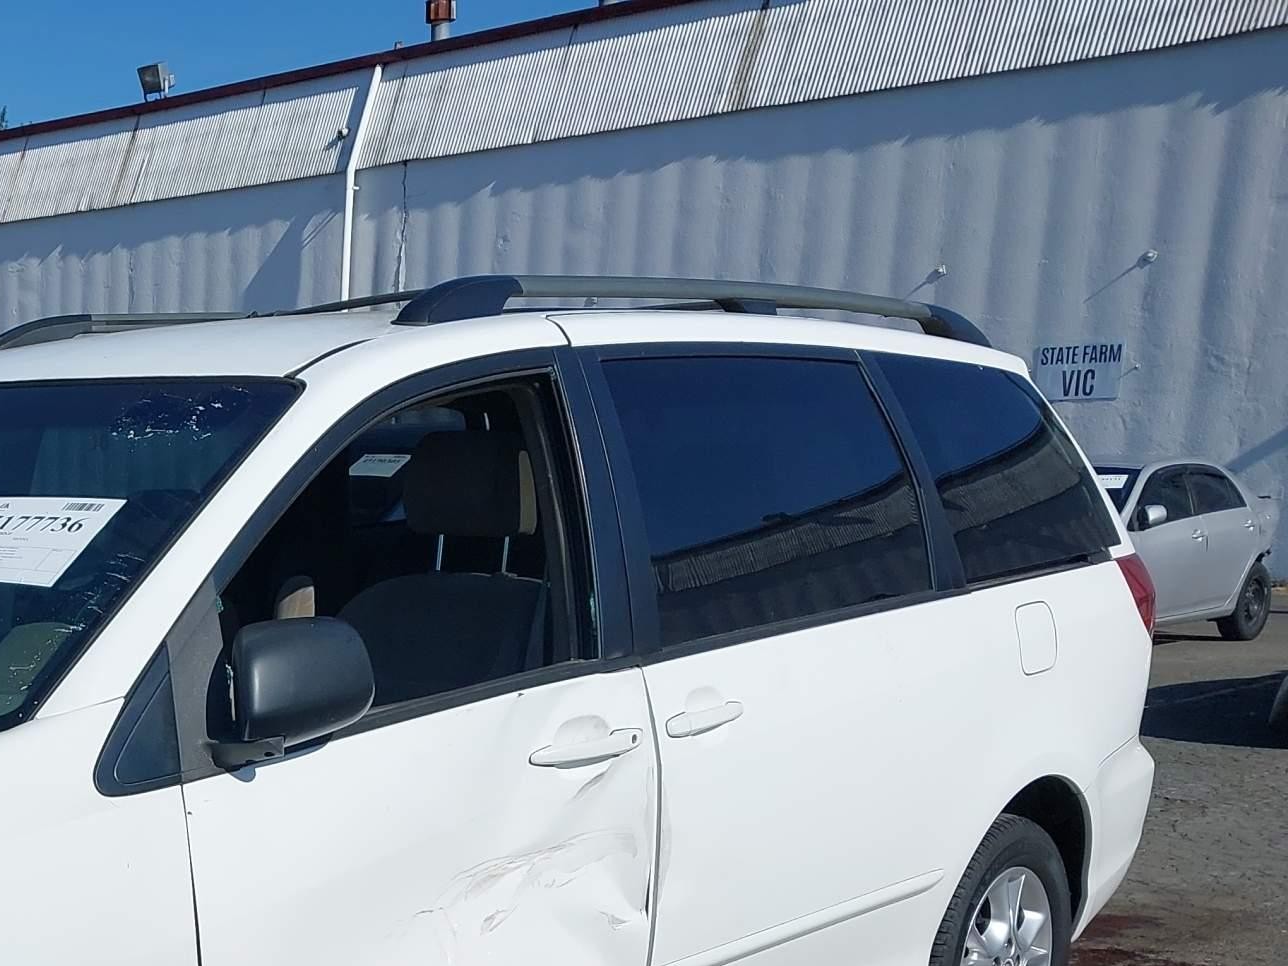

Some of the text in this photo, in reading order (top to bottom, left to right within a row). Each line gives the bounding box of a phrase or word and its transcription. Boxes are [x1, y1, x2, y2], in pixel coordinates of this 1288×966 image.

[1040, 343, 1123, 366] STATE FARM
[1061, 368, 1096, 397] VIC
